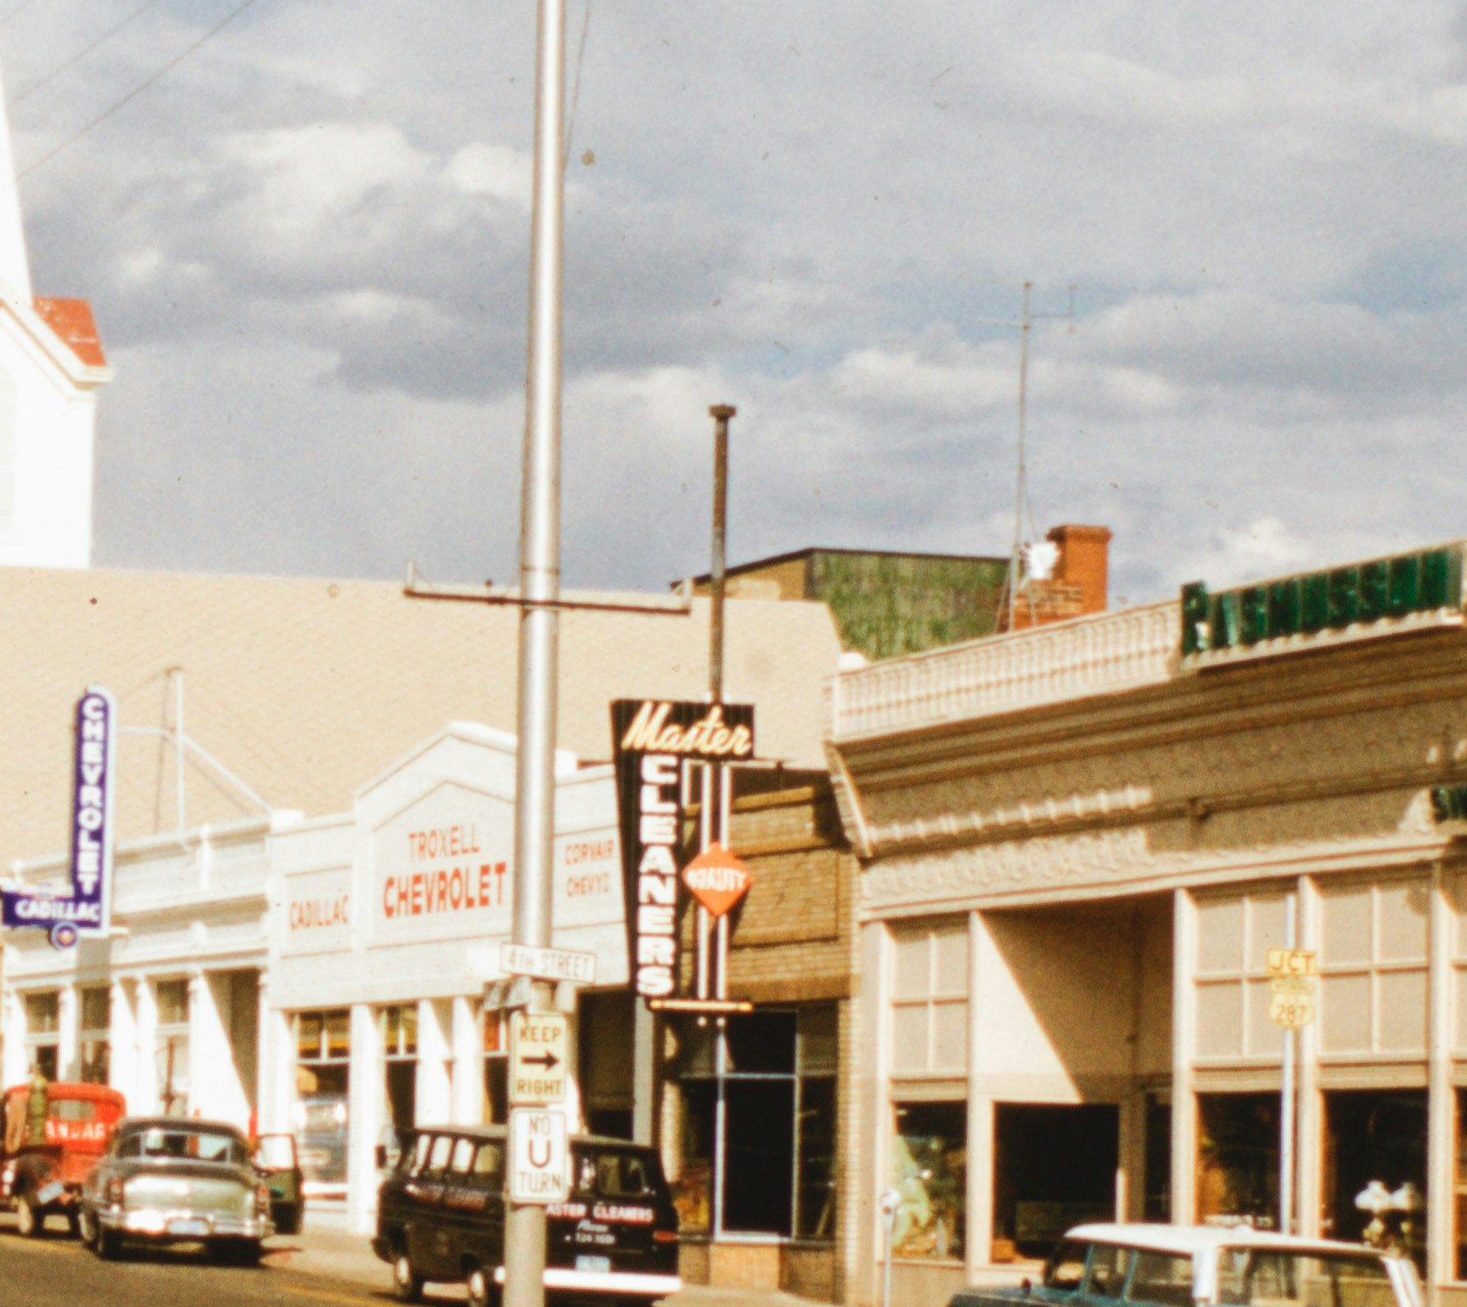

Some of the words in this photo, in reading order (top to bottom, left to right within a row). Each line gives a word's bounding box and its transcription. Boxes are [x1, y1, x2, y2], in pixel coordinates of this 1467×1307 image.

[622, 701, 751, 756] Master
[77, 696, 105, 897] CHEVROLET
[408, 823, 481, 863] TROXELL
[564, 838, 614, 866] CORVAIR
[635, 754, 679, 997] CLEANERS
[685, 867, 747, 892] QUALITY
[383, 862, 507, 919] CHEVROLET
[14, 898, 102, 923] CADILLAC
[289, 895, 351, 931] CADILLAC
[508, 948, 534, 968] 4TH
[540, 951, 590, 979] STREET
[1271, 950, 1314, 974] JCT
[1275, 1004, 1307, 1024] 287
[519, 1026, 562, 1044] KEEP
[517, 1079, 562, 1095] RIGHT
[529, 1116, 551, 1137] NO
[528, 1139, 550, 1168] U
[519, 1171, 561, 1193] TURN
[545, 1204, 587, 1218] ASTER
[593, 1205, 654, 1222] CLEANERS
